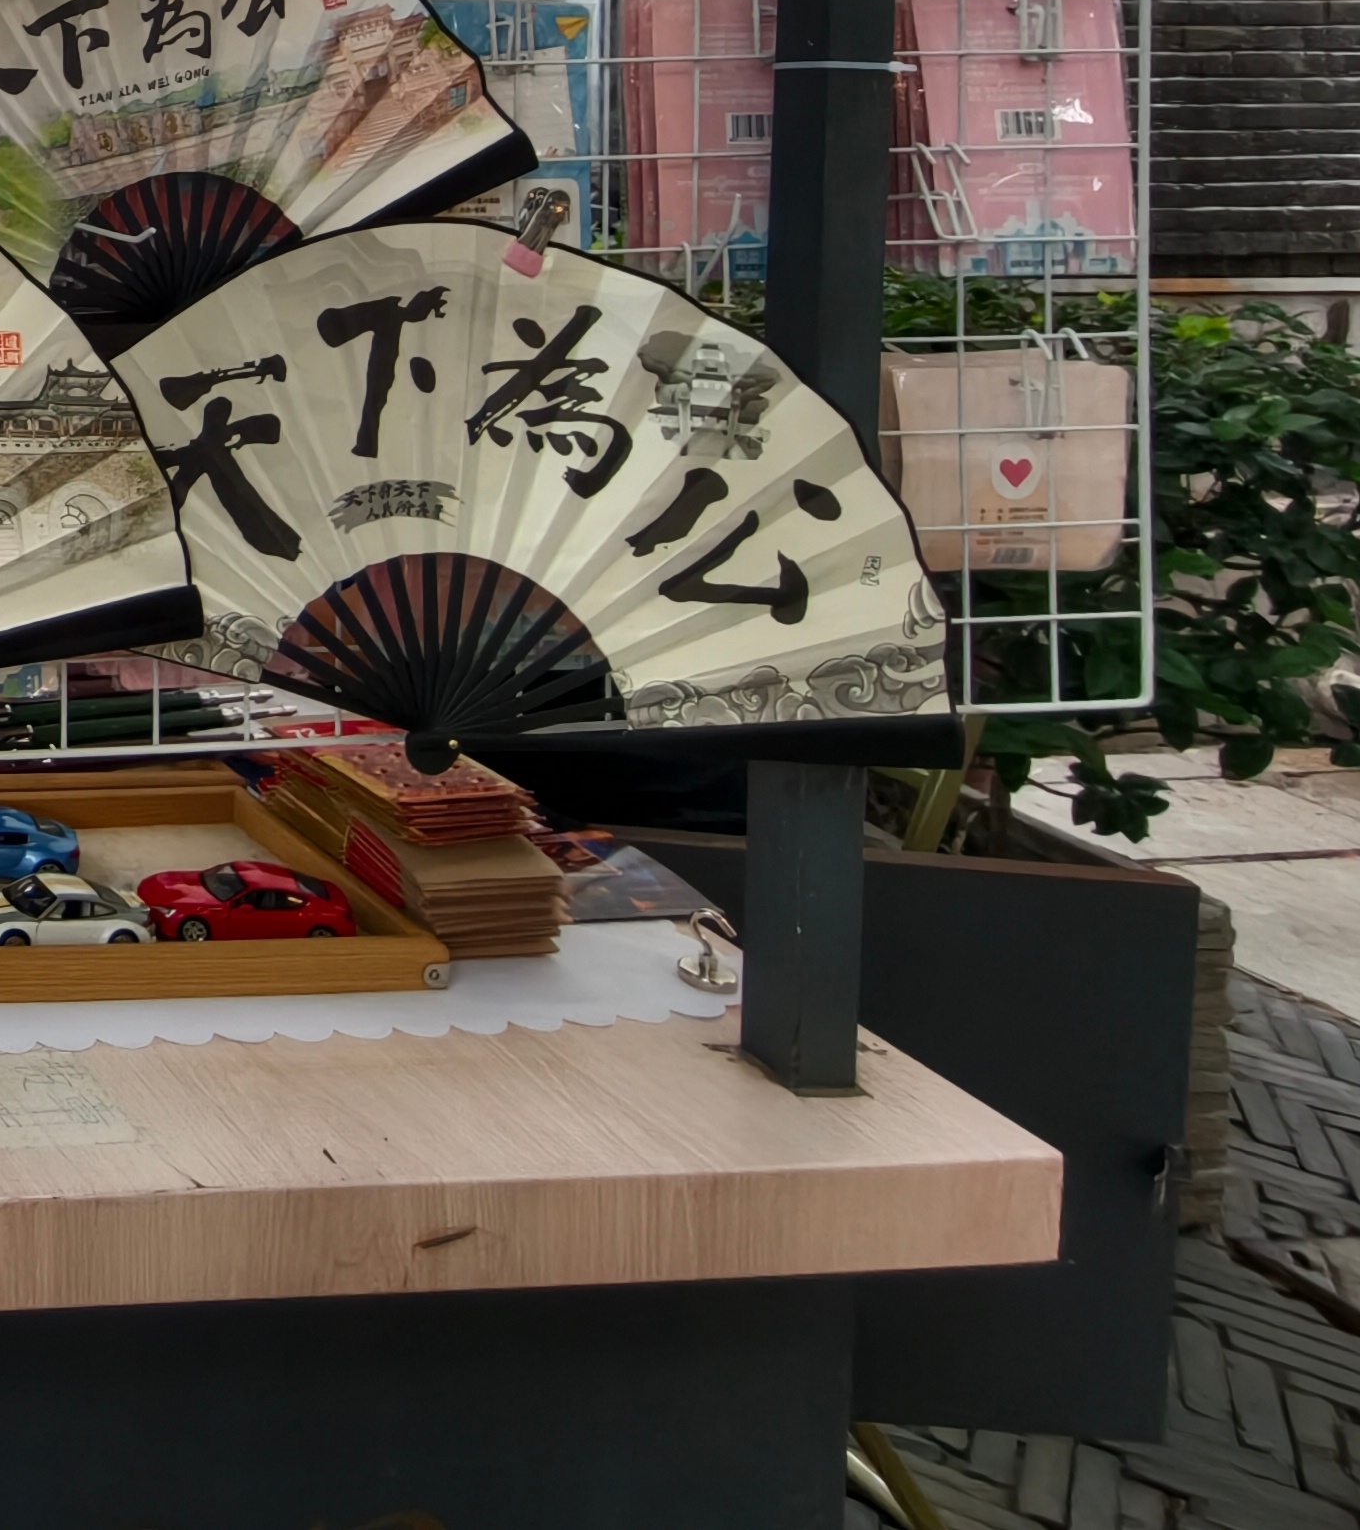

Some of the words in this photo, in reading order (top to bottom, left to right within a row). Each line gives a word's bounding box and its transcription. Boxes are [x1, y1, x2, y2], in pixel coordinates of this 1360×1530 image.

[79, 91, 113, 107] TIAN
[147, 74, 171, 91] WEI
[174, 65, 211, 84] GONG
